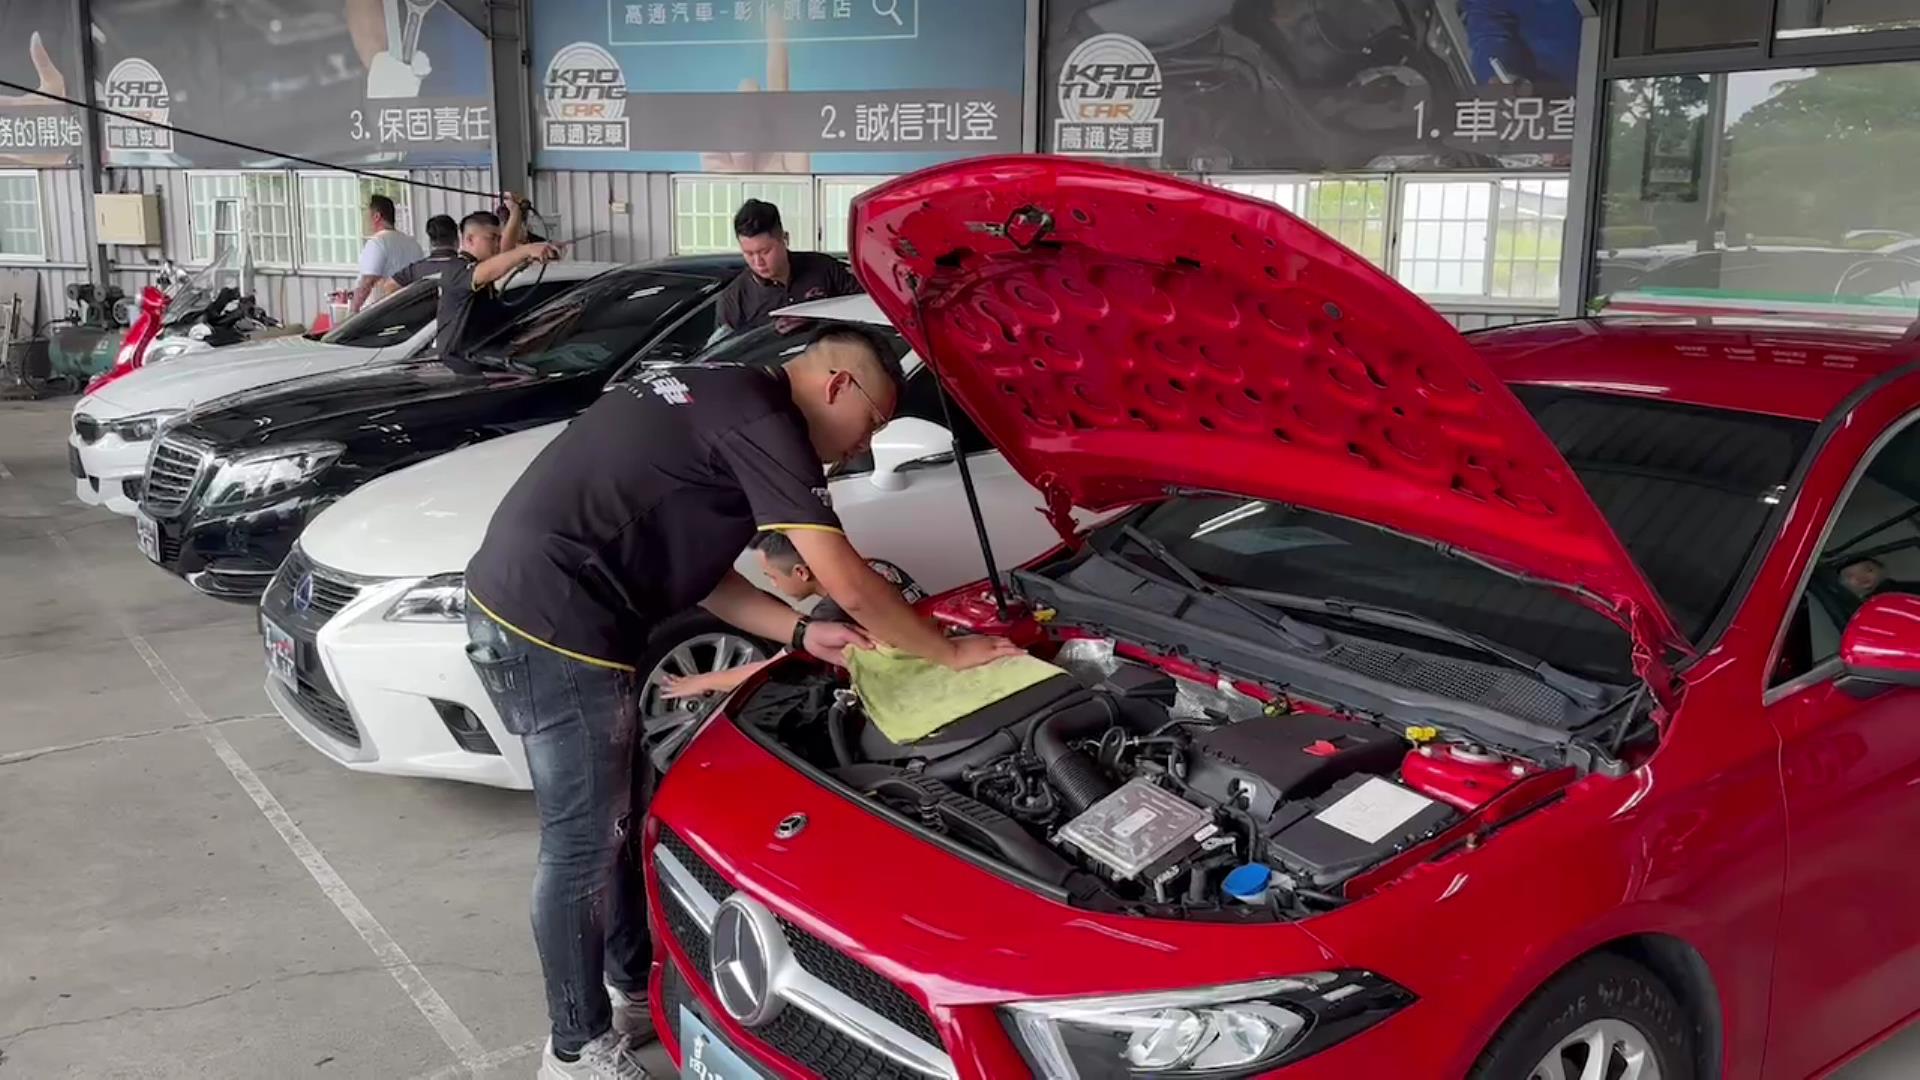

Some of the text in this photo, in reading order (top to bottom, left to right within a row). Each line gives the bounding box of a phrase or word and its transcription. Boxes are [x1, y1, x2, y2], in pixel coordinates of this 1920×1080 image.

[549, 67, 620, 86] KAO
[1065, 63, 1155, 84] KAO
[109, 81, 163, 95] KAO
[562, 103, 606, 117] CAR
[1080, 103, 1135, 119] CAR
[378, 106, 490, 143] 保固責任
[855, 101, 998, 142] 誠信刊登
[1060, 125, 1154, 151] 高通汽車
